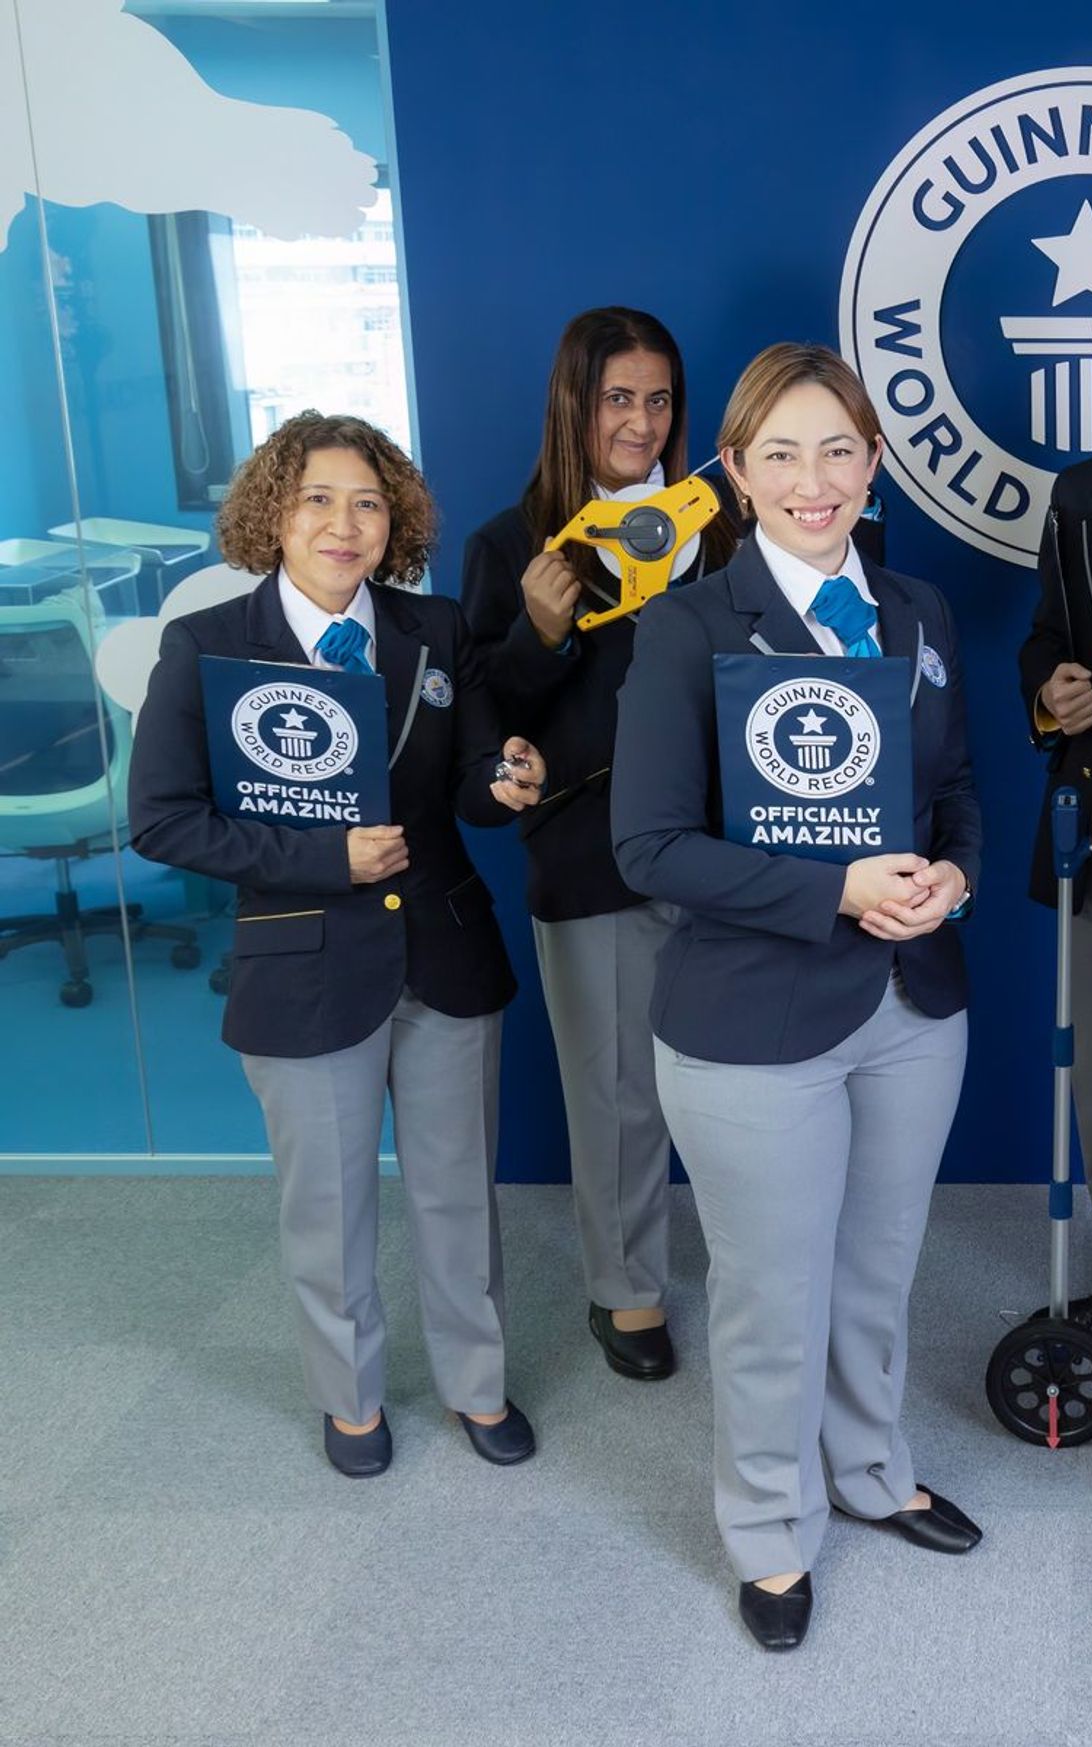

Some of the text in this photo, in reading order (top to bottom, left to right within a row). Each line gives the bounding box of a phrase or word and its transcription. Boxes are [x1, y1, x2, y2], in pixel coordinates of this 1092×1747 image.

[873, 298, 1031, 521] WORLD
[249, 689, 338, 719] GUINNESS
[764, 686, 859, 718] GUINNESS
[240, 722, 349, 775] WORLD RECORDS
[755, 731, 871, 791] WORLD RECORDS
[236, 780, 360, 805] OFFICIALLY
[239, 796, 361, 822] AMAZING
[750, 806, 881, 823] OFFICIALLY
[752, 825, 882, 846] AMAZING
